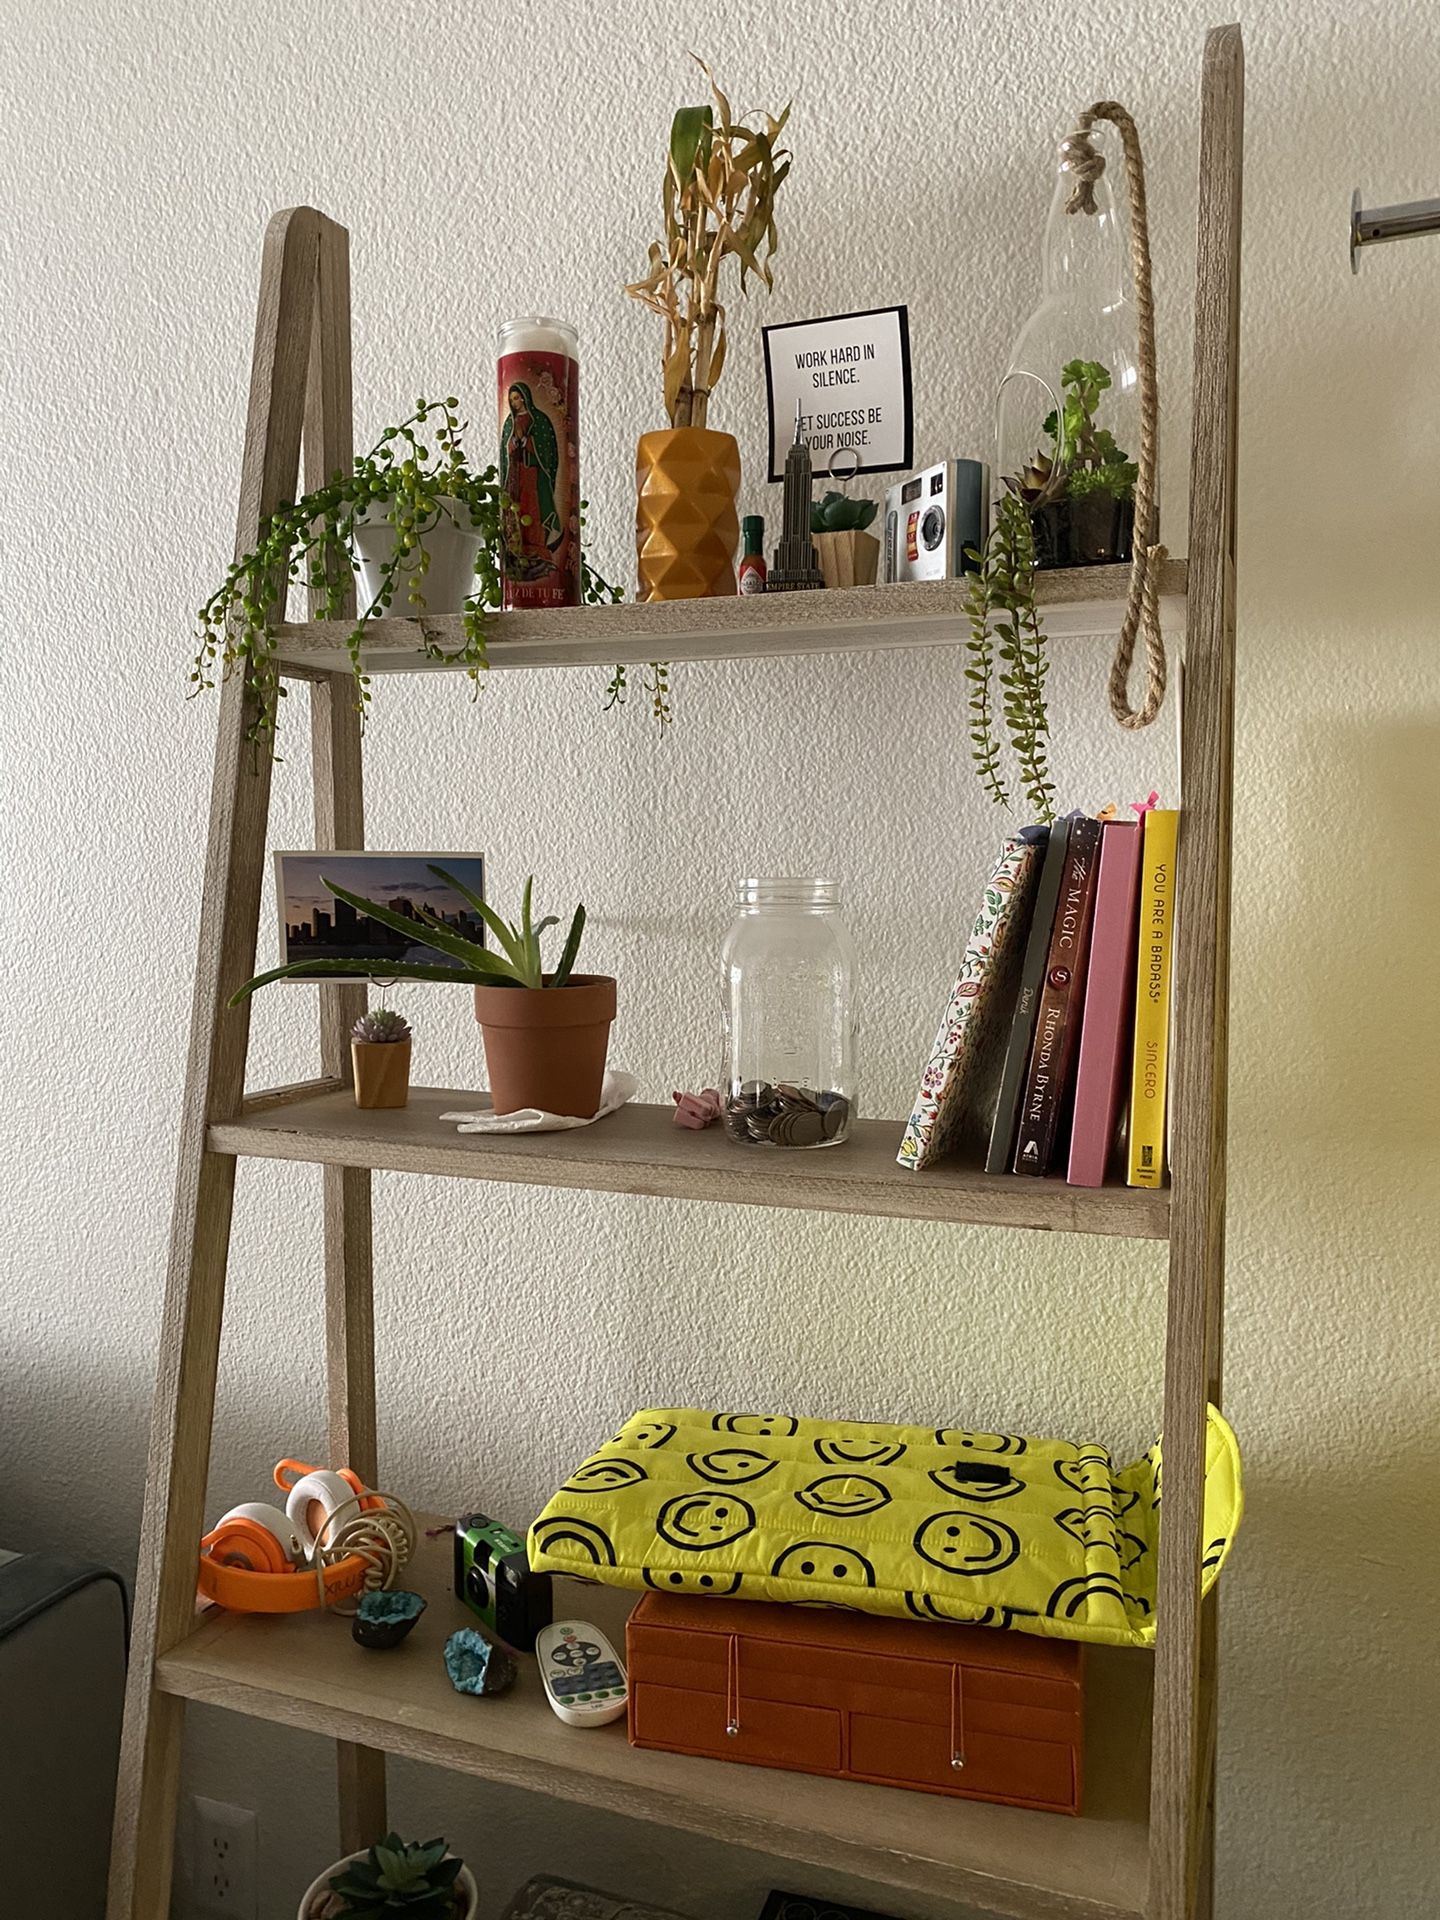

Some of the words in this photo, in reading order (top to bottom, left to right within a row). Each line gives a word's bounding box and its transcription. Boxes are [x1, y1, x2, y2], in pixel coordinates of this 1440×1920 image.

[795, 350, 828, 369] WORK
[831, 345, 861, 365] HARD
[863, 343, 875, 360] IN
[812, 368, 860, 389] SILENCE.
[795, 415, 814, 431] ET
[817, 409, 865, 430] SUCCESS
[868, 407, 882, 424] BE
[805, 434, 834, 451] YOUR
[837, 430, 871, 448] NOISE.
[768, 582, 795, 591] EMPIRE
[797, 582, 819, 590] STATE
[1071, 857, 1086, 881] The
[1153, 864, 1166, 893] YOU
[1060, 888, 1082, 949] MAGIC
[1152, 899, 1165, 925] ARE
[1152, 930, 1163, 939] A
[1038, 1008, 1061, 1070] RHONDA
[1144, 1040, 1158, 1099] SINCERO
[1030, 1074, 1049, 1122] BYRNE
